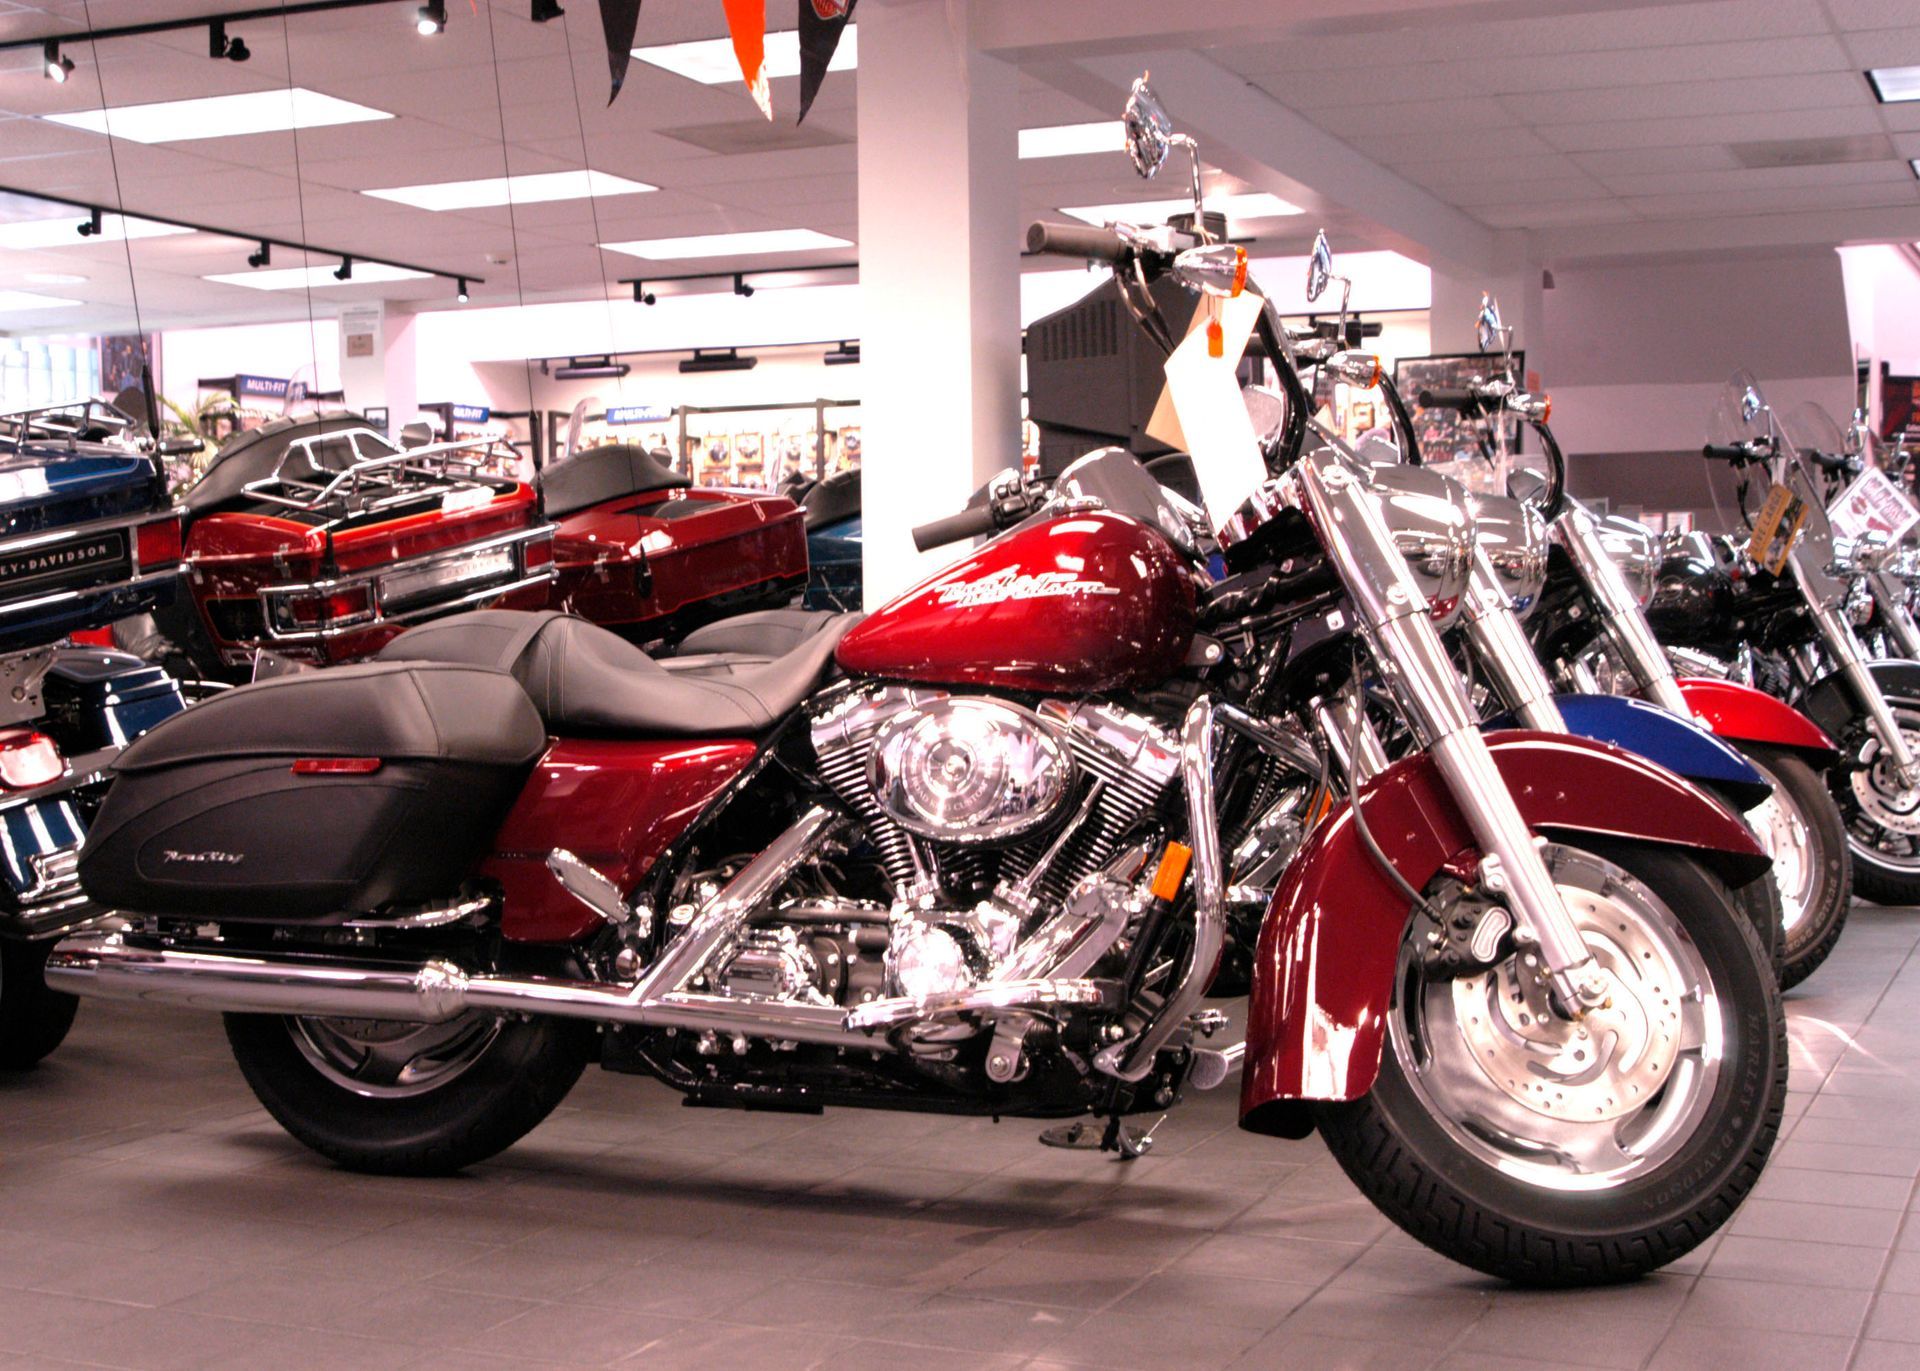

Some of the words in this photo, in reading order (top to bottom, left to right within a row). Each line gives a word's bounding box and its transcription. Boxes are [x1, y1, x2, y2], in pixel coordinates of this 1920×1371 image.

[246, 378, 287, 393] MULTI-FIT
[1741, 1012, 1761, 1113] HARLEY
[1643, 1133, 1735, 1210] DAVIDSON
